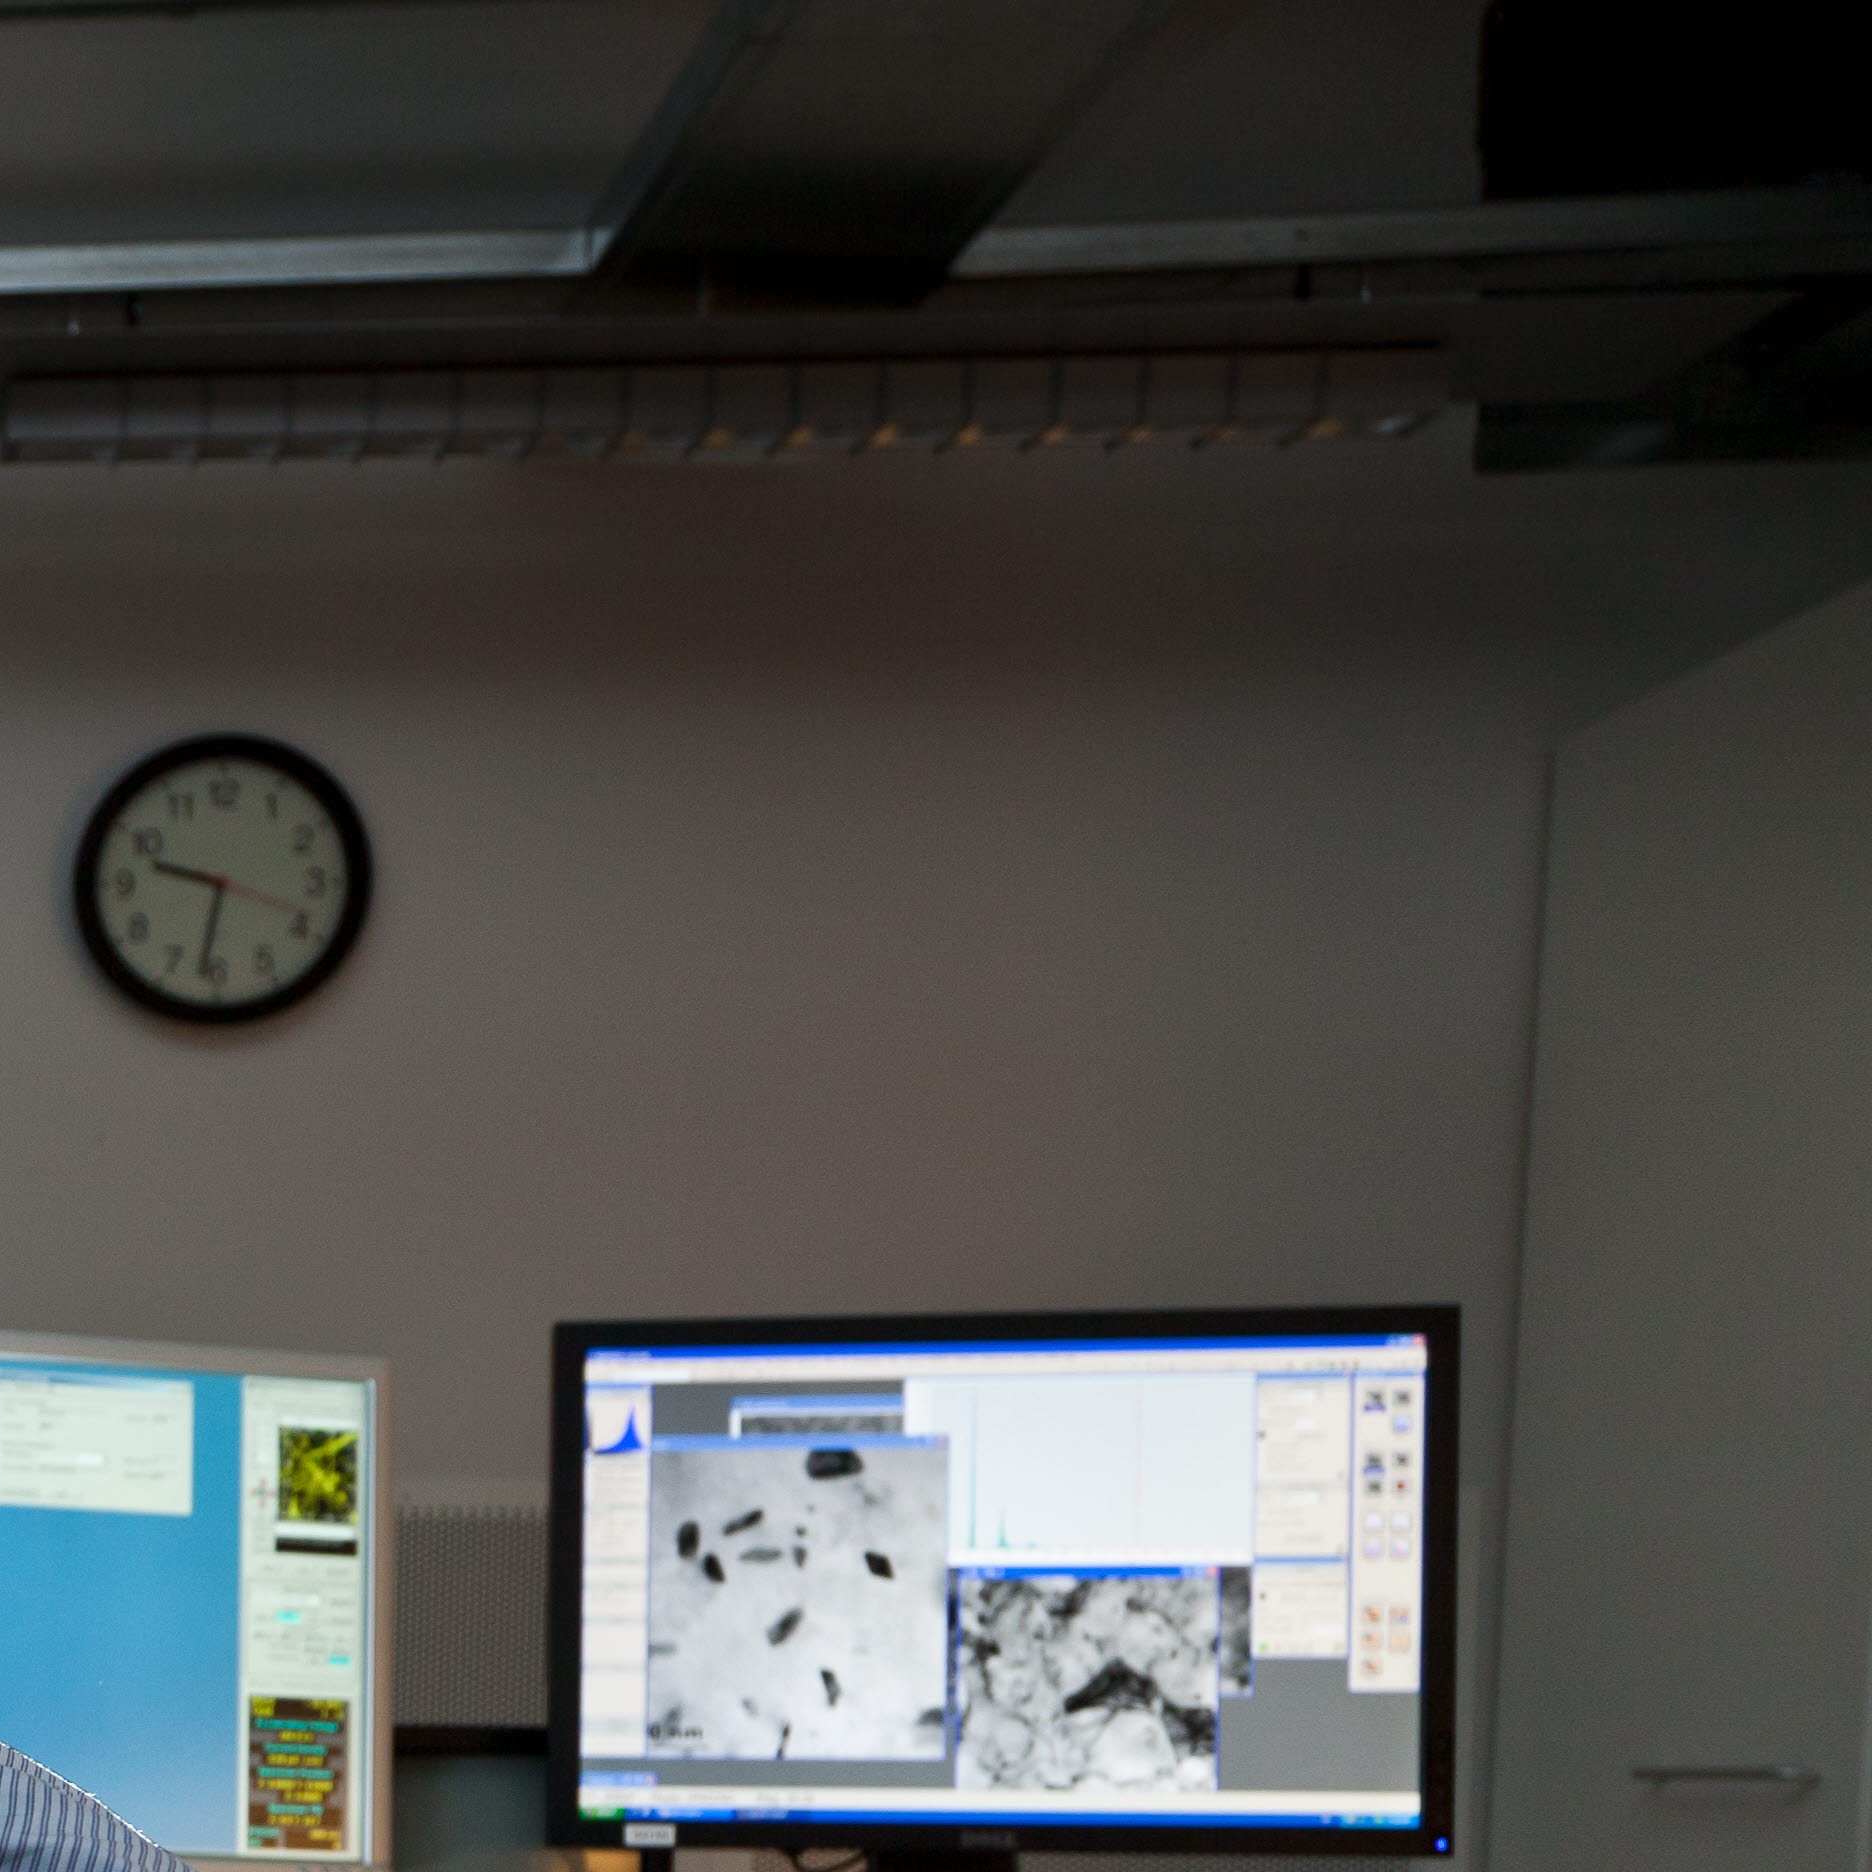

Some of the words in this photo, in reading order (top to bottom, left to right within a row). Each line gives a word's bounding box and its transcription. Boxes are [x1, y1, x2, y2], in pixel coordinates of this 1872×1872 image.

[166, 791, 194, 821] 11
[207, 777, 241, 811] 12
[264, 791, 279, 822] 1
[131, 825, 163, 858] 10
[292, 822, 316, 855] 2
[114, 866, 137, 898] 9
[306, 864, 327, 898] 3
[288, 910, 310, 941] 4
[163, 943, 186, 977] 7
